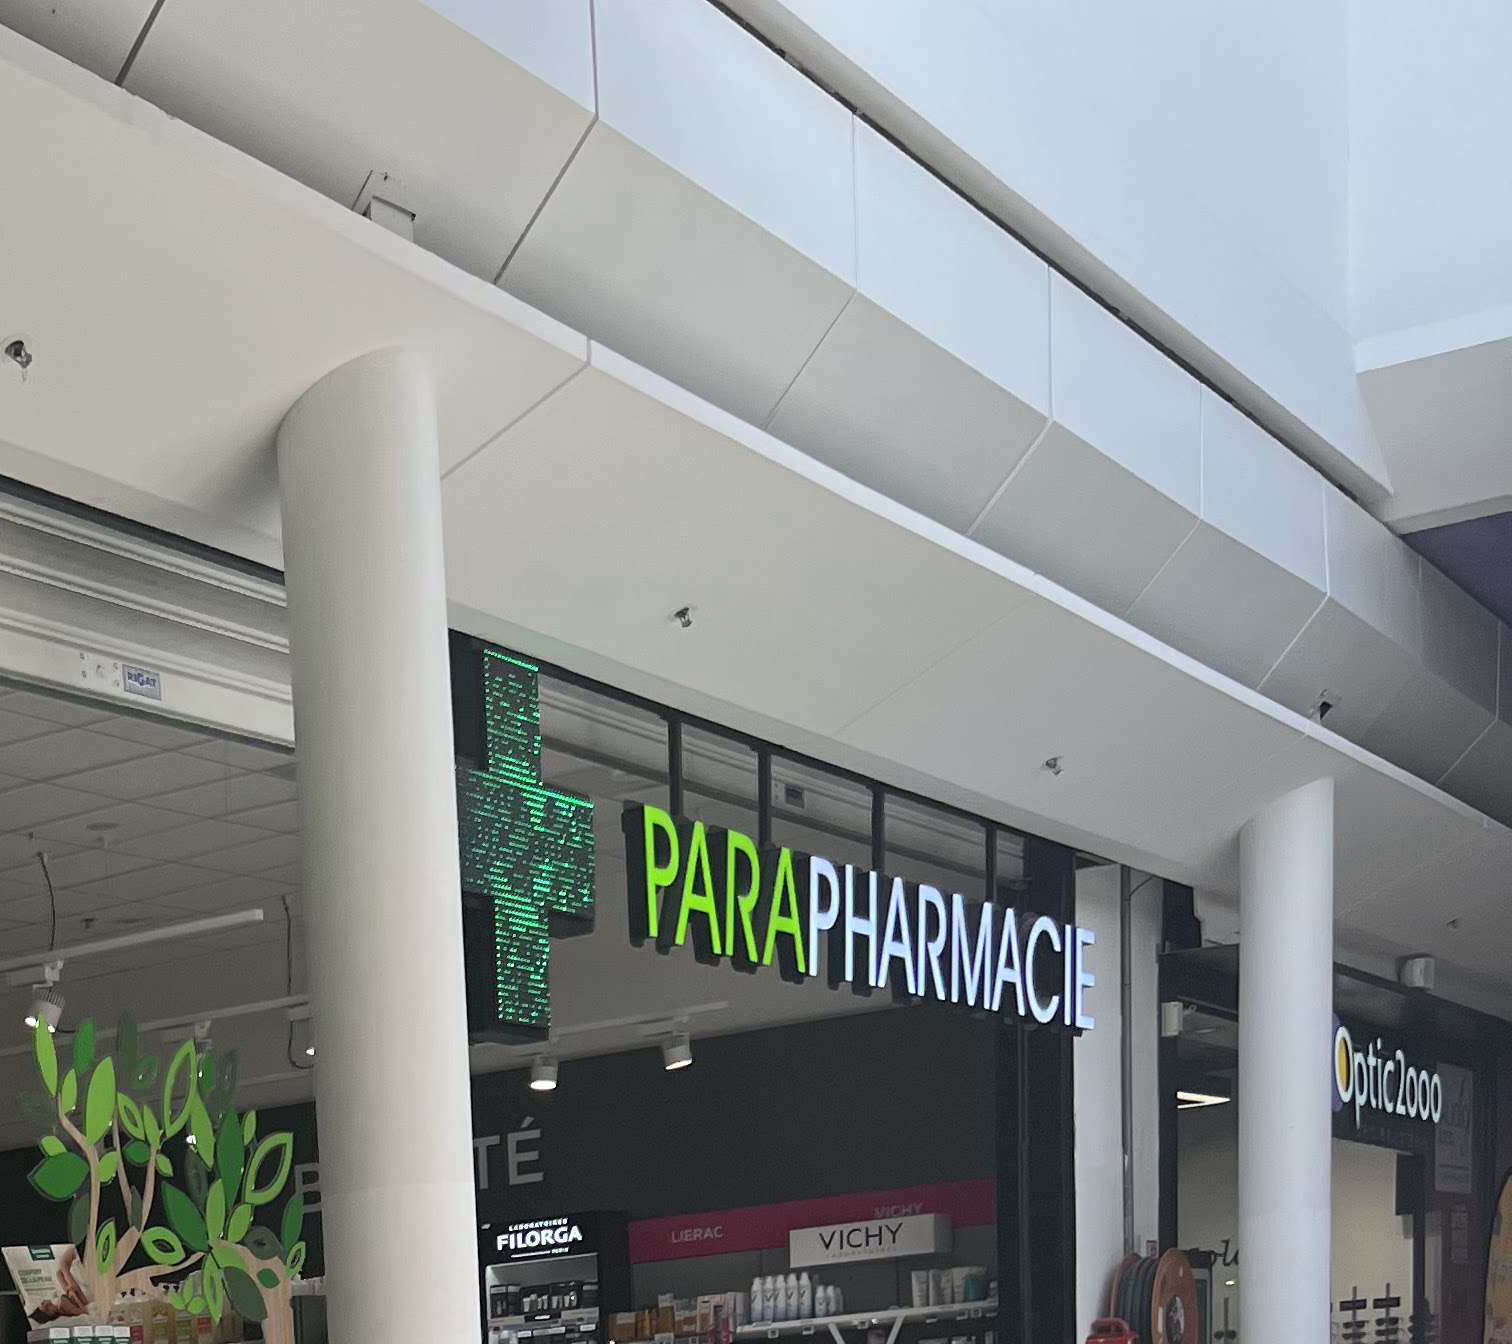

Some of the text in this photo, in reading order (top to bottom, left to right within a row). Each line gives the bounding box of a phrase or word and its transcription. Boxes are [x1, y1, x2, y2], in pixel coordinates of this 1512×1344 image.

[643, 804, 1095, 1030] PARAPHARMACIE
[496, 1224, 583, 1251] FILORGA
[671, 1226, 724, 1244] LIERAC
[818, 1222, 904, 1251] VICHY
